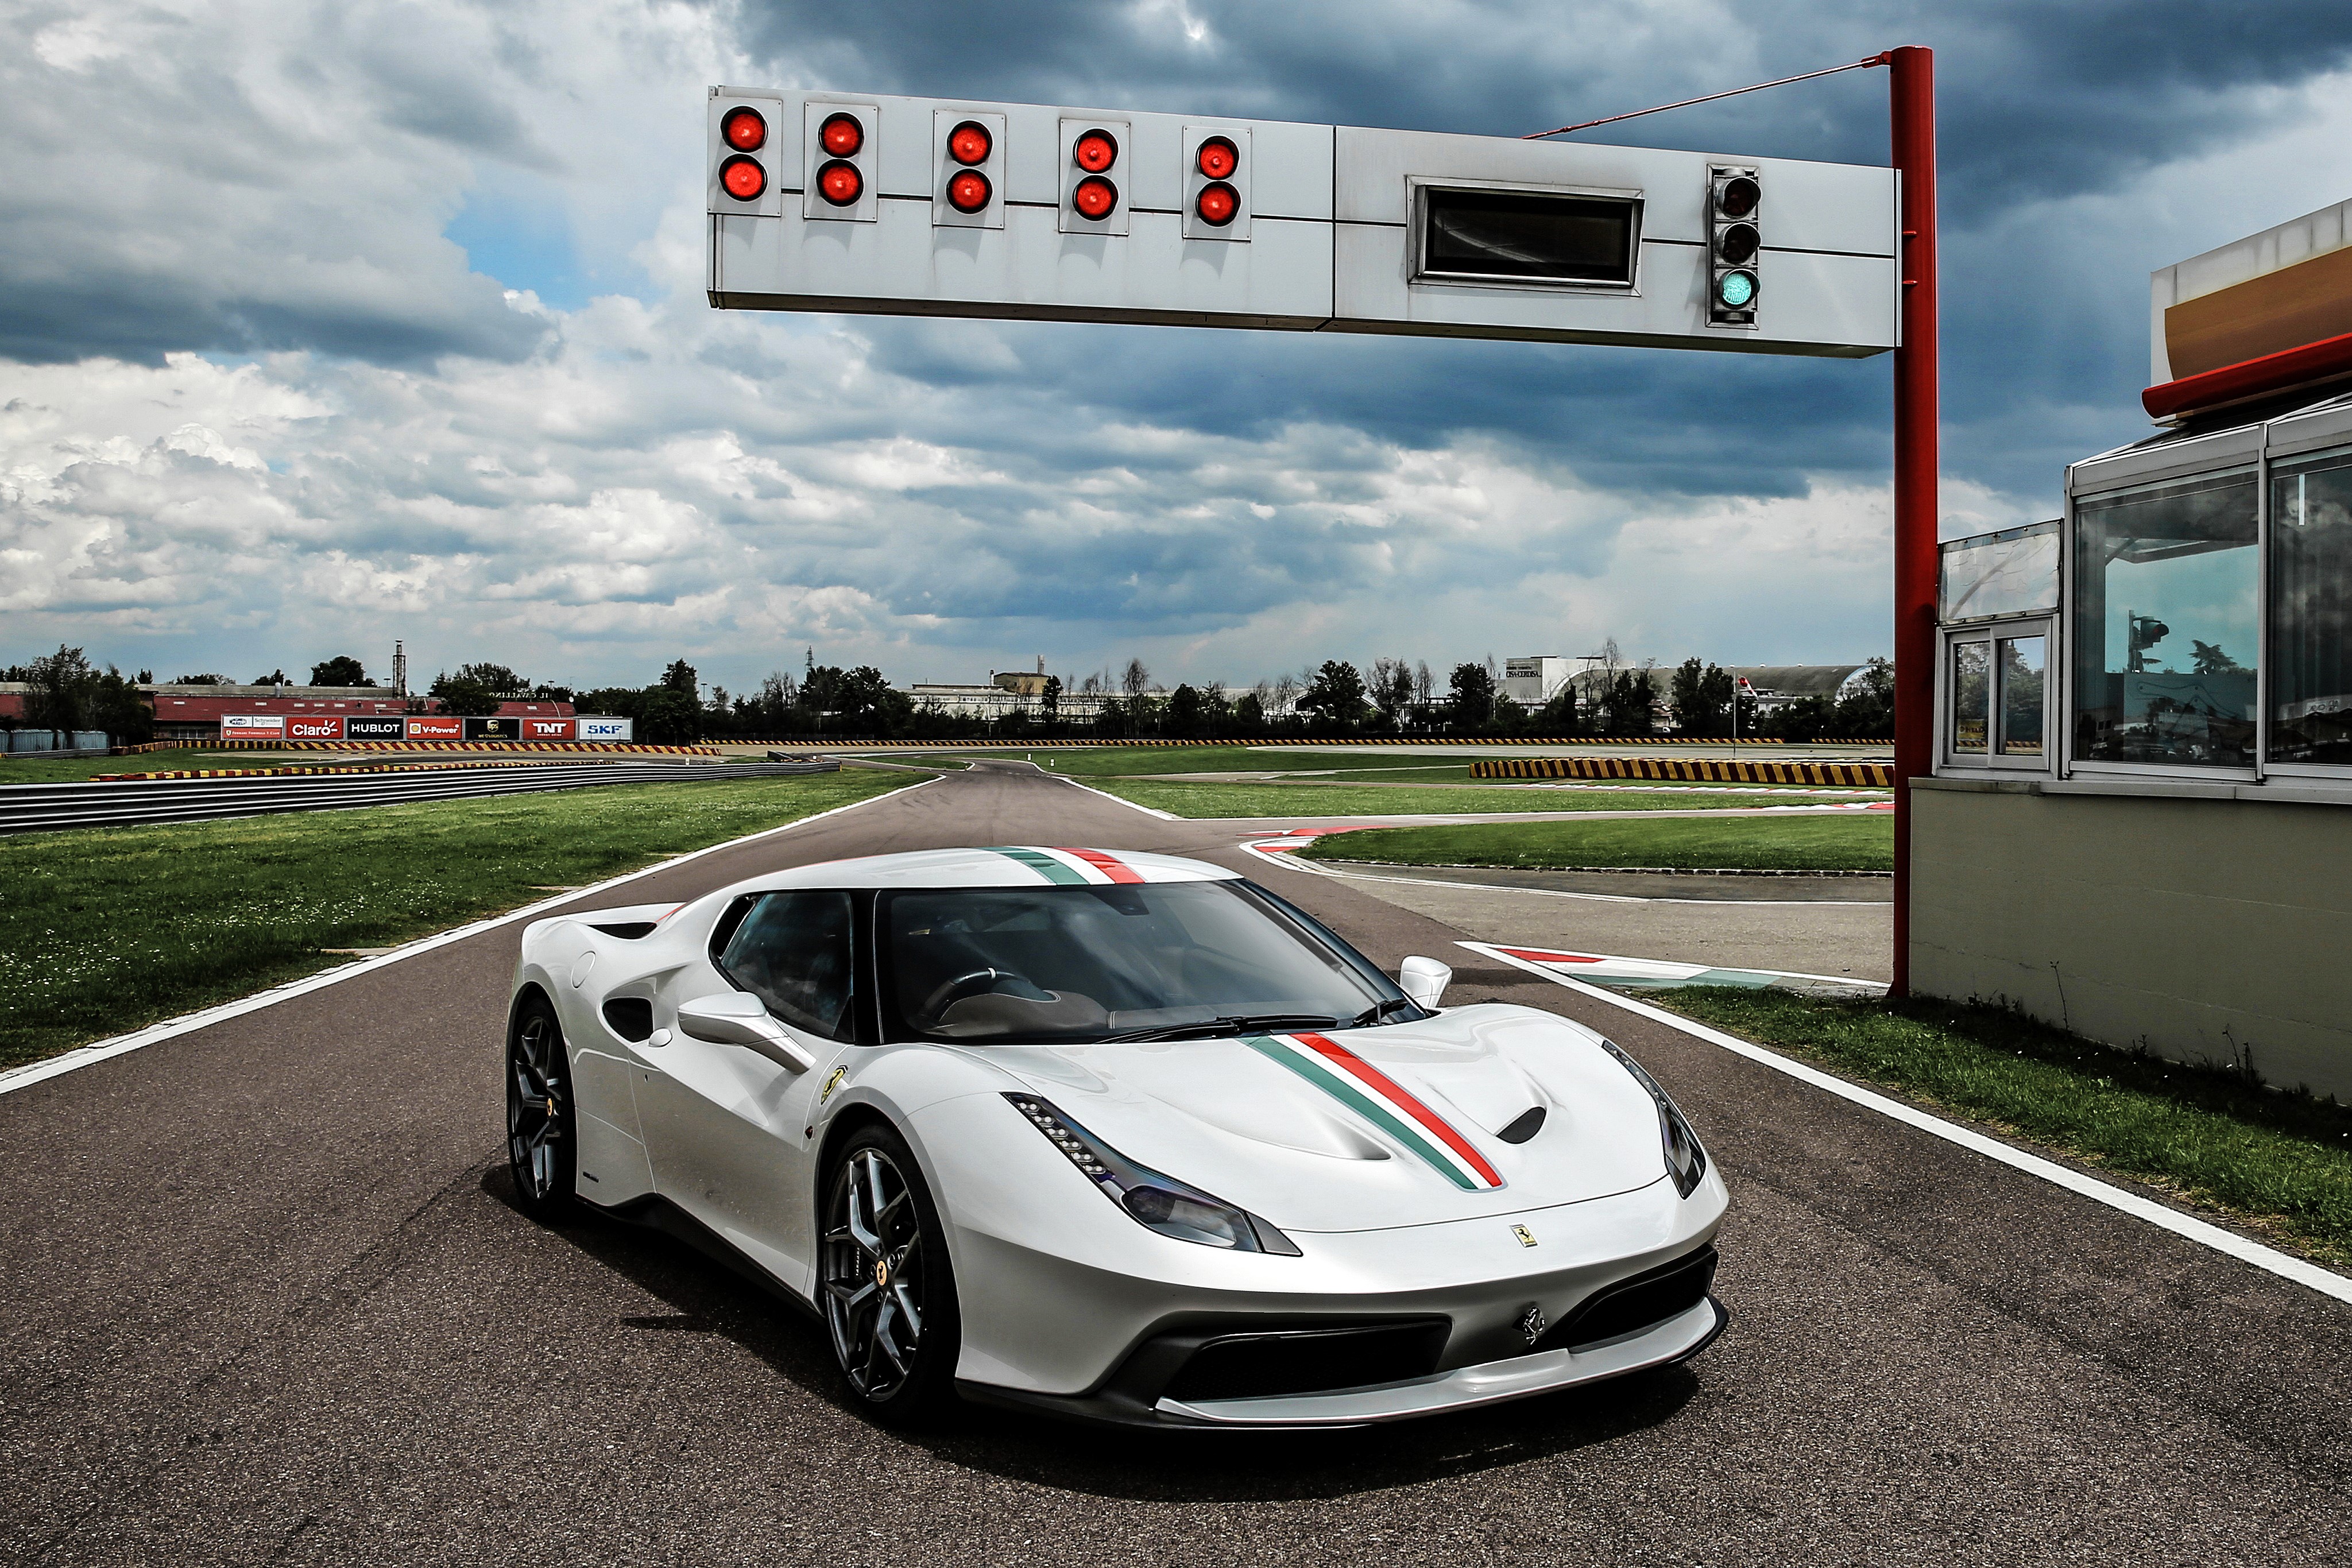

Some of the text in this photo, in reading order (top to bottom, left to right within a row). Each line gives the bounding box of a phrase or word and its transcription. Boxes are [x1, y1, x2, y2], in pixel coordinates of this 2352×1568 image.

[292, 724, 331, 735] Claro
[351, 723, 400, 733] HUBLOT
[532, 723, 567, 733] TNT
[587, 725, 622, 734] SKF
